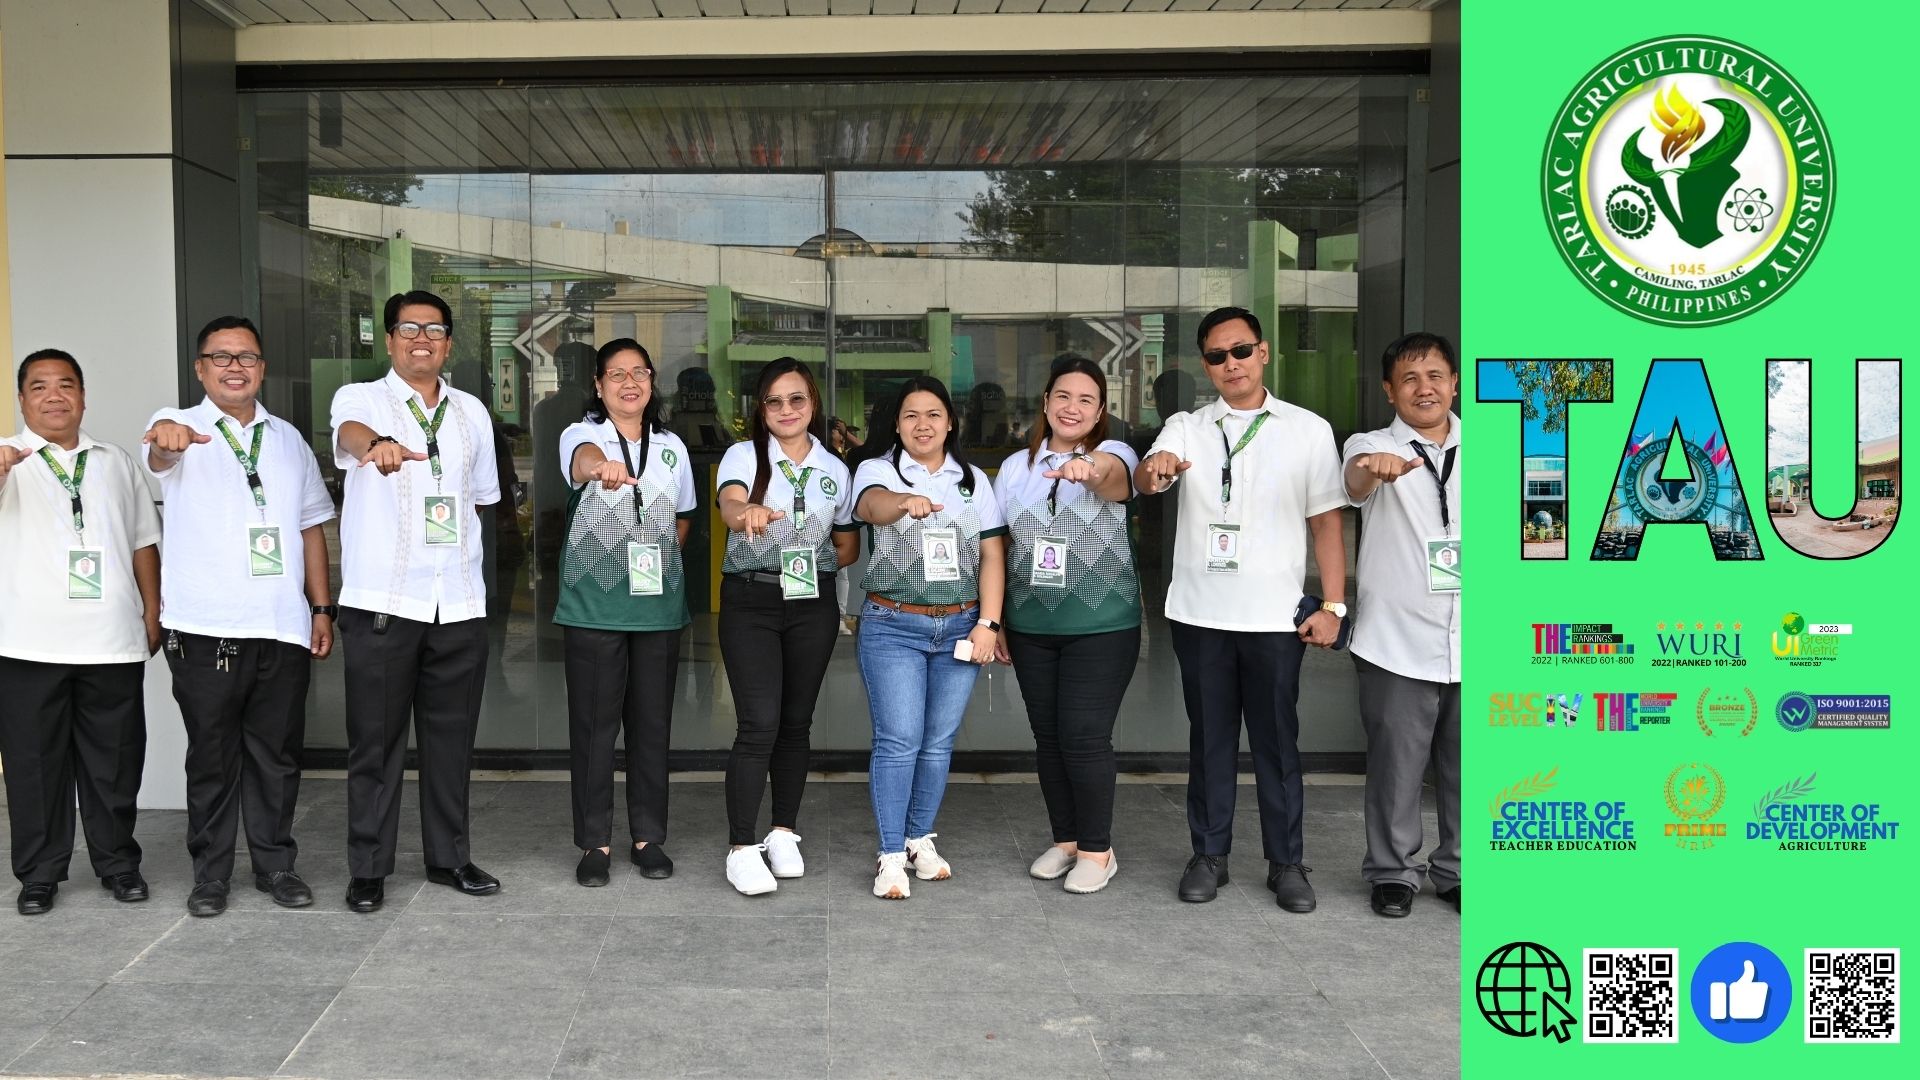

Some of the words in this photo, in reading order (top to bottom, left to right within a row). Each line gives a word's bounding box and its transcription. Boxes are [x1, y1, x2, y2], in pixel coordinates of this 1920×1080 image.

[1631, 441, 1698, 472] AGRICUAL
[1626, 477, 1645, 517] TARLAC
[1701, 459, 1717, 515] UNIVERSITY
